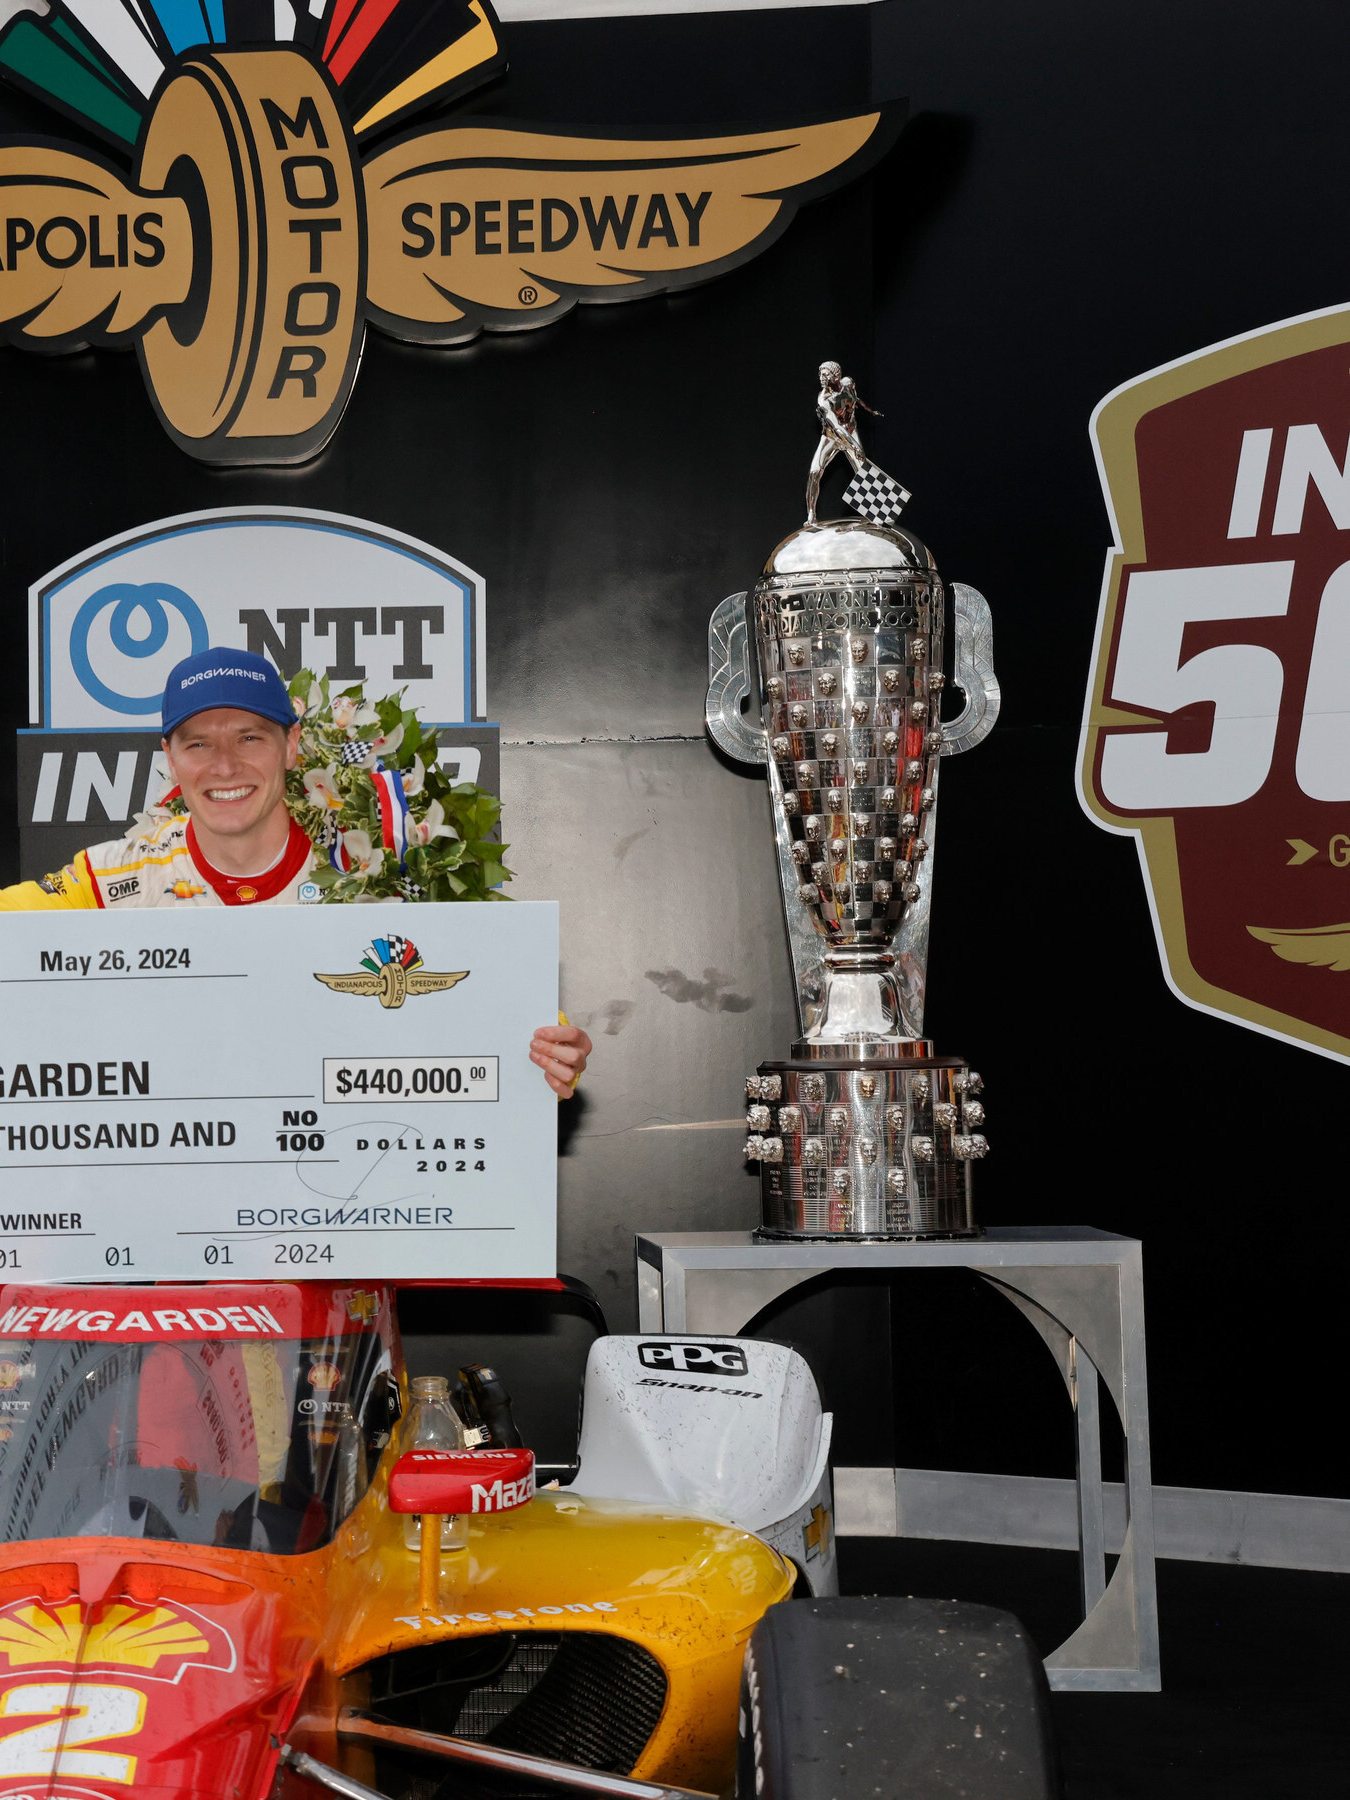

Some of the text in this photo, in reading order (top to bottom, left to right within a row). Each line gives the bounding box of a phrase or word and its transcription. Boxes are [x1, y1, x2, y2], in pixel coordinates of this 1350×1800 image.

[401, 191, 713, 258] SPEEDWAY
[260, 97, 342, 399] MOTOR
[238, 605, 444, 681] NTT
[180, 667, 267, 690] BORGWARNER
[107, 879, 140, 898] OMP
[40, 948, 191, 977] May 26, 2024
[334, 981, 383, 989] INDIANAPOLIS
[394, 968, 403, 1003] MOTOR
[411, 979, 448, 987] SPEEDWAY
[282, 1110, 318, 1127] NO
[170, 1121, 237, 1148] AND
[276, 1133, 325, 1152] 100
[356, 1138, 487, 1151] DOLLARS
[416, 1160, 487, 1173] 2024
[0, 1213, 83, 1231] WINNER
[237, 1207, 454, 1227] BORGWARNER
[105, 1247, 135, 1267] 01
[204, 1245, 234, 1265] 01
[274, 1243, 335, 1264] 2024
[641, 1344, 745, 1371] PPG
[1, 1401, 31, 1411] NTT
[321, 1402, 351, 1413] NTT
[411, 1452, 518, 1461] SIEMENS
[393, 1600, 619, 1630] Firestone
